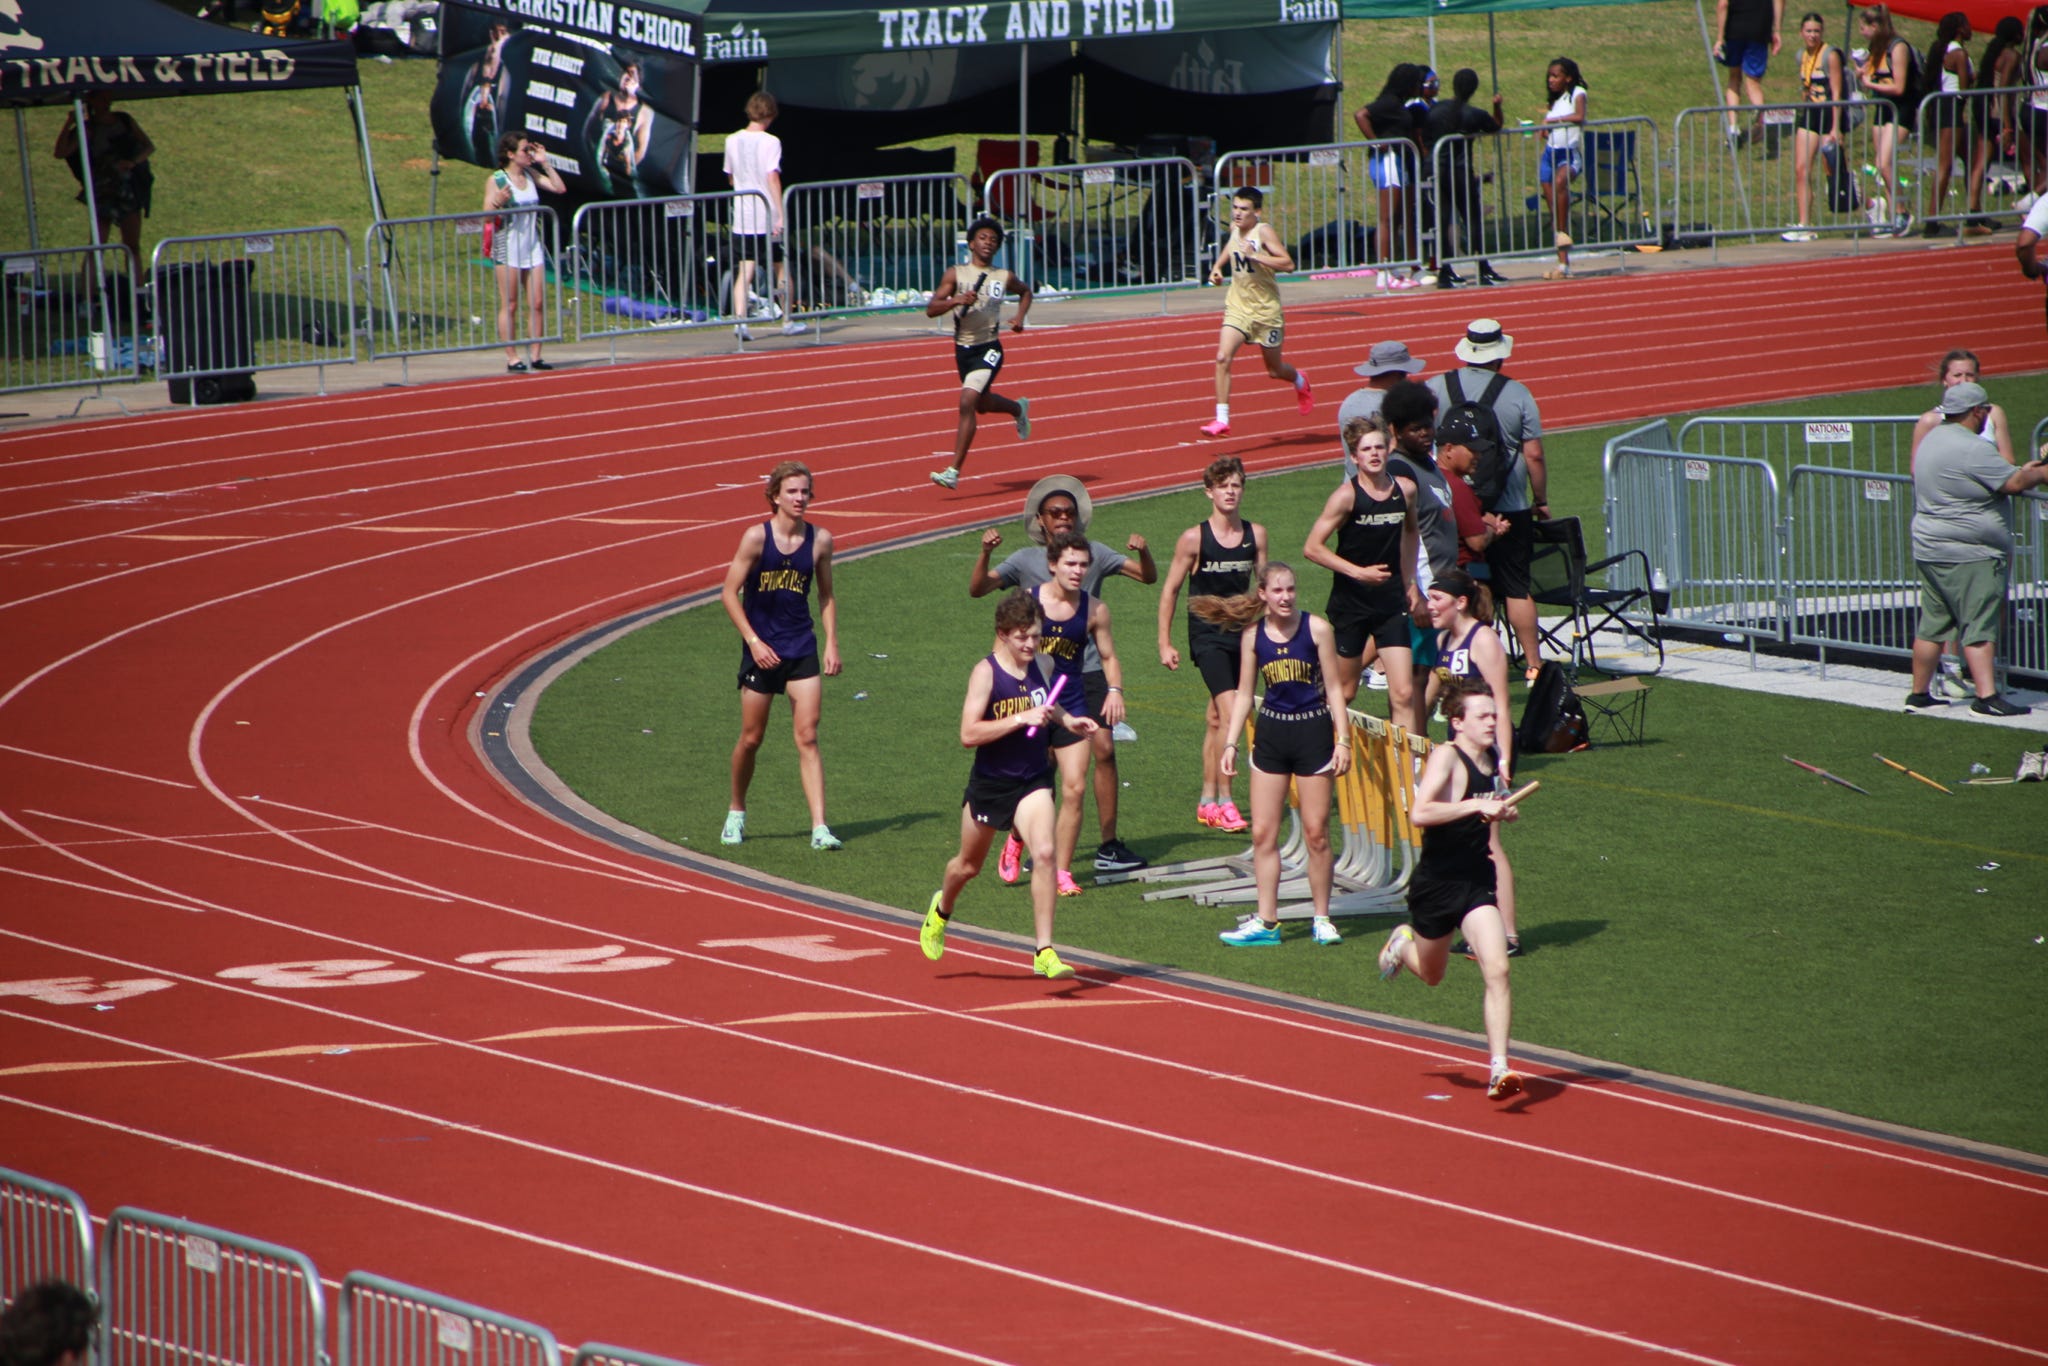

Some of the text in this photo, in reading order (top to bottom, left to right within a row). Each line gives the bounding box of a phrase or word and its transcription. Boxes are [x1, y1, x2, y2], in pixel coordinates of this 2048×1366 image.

[1279, 0, 1339, 22] Faith
[618, 6, 696, 56] SCHOOL
[878, 0, 1175, 48] TRACK AND FIELD
[703, 22, 768, 60] Faith
[6, 49, 296, 88] TRACK & FIELD
[1233, 250, 1255, 274] M
[993, 281, 1002, 298] 6
[1268, 329, 1279, 344] 8
[1808, 423, 1851, 433] NATIONAL
[1455, 651, 1465, 673] 5
